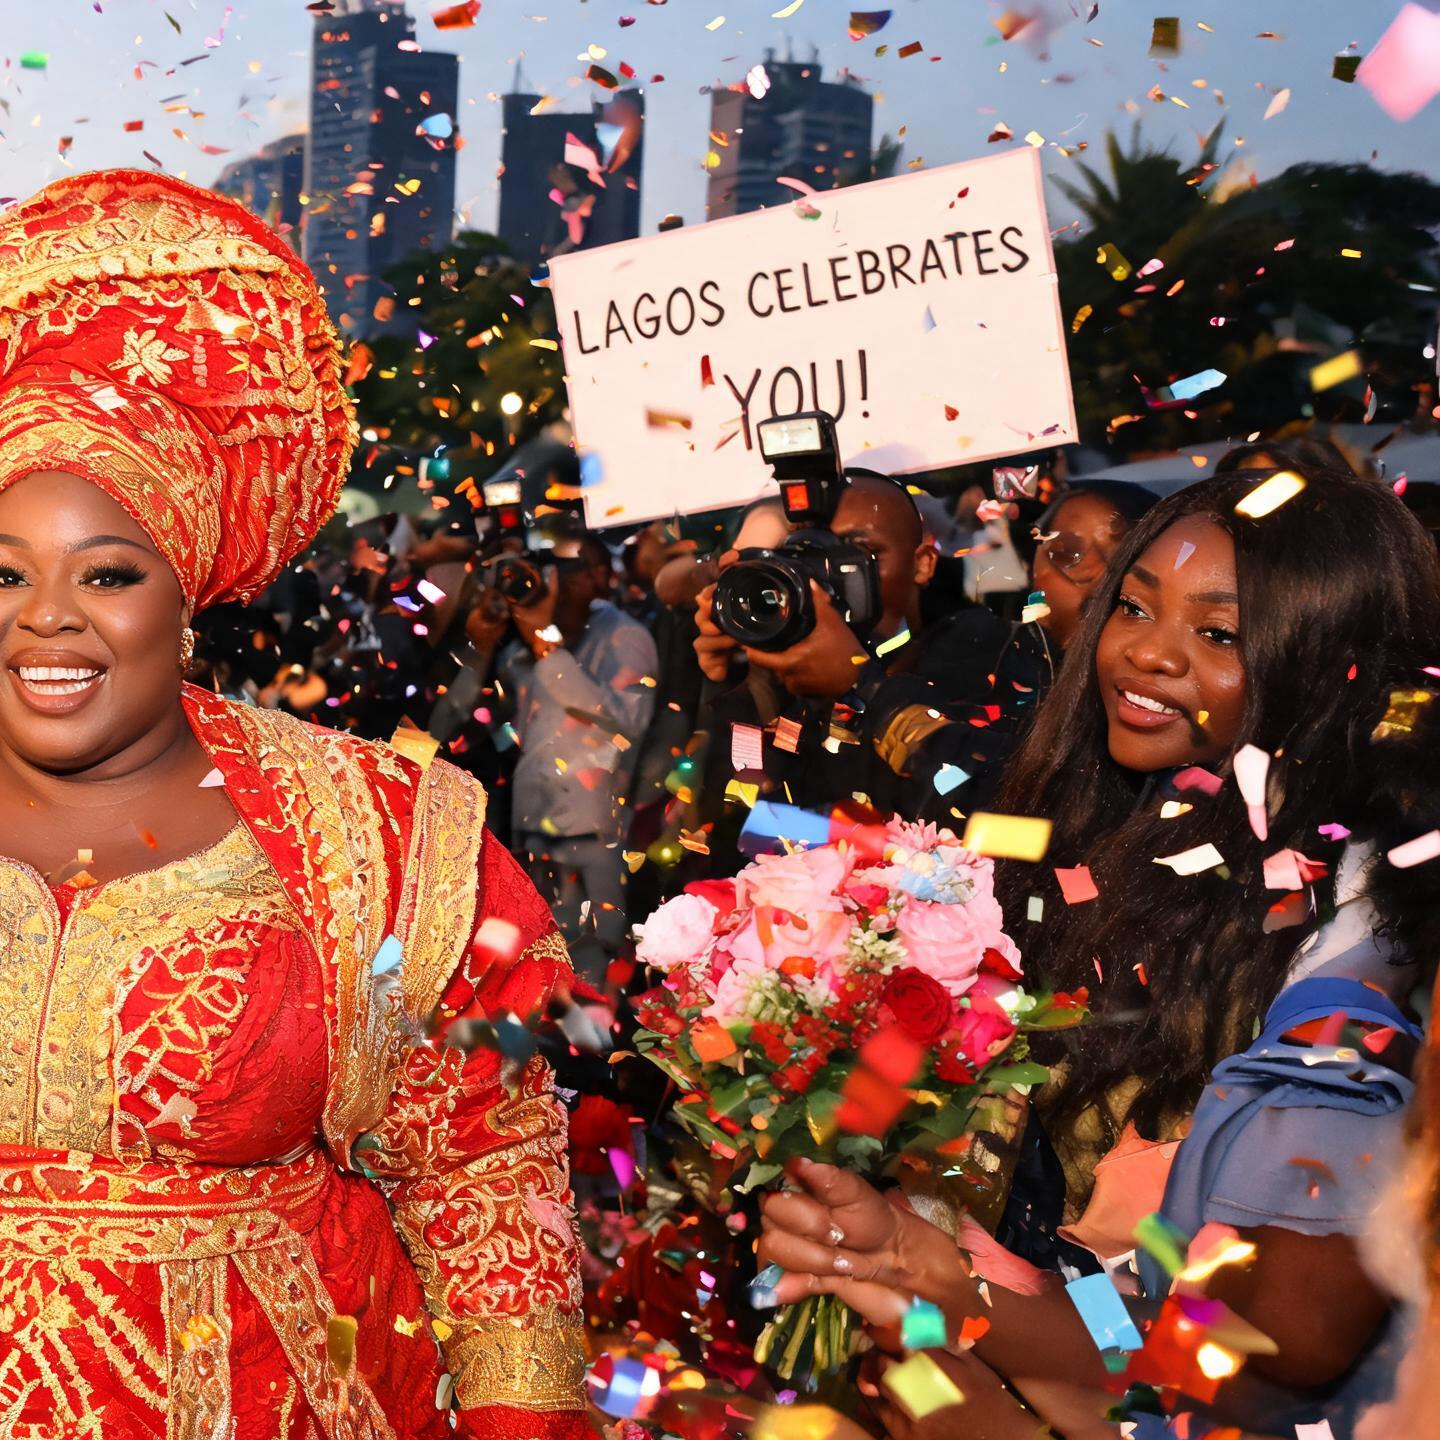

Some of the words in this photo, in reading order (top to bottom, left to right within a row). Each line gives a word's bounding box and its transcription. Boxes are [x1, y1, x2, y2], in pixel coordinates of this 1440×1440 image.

[574, 281, 725, 354] LAGOS
[747, 226, 1030, 319] CELEBRATES
[723, 349, 868, 451] YOU!
